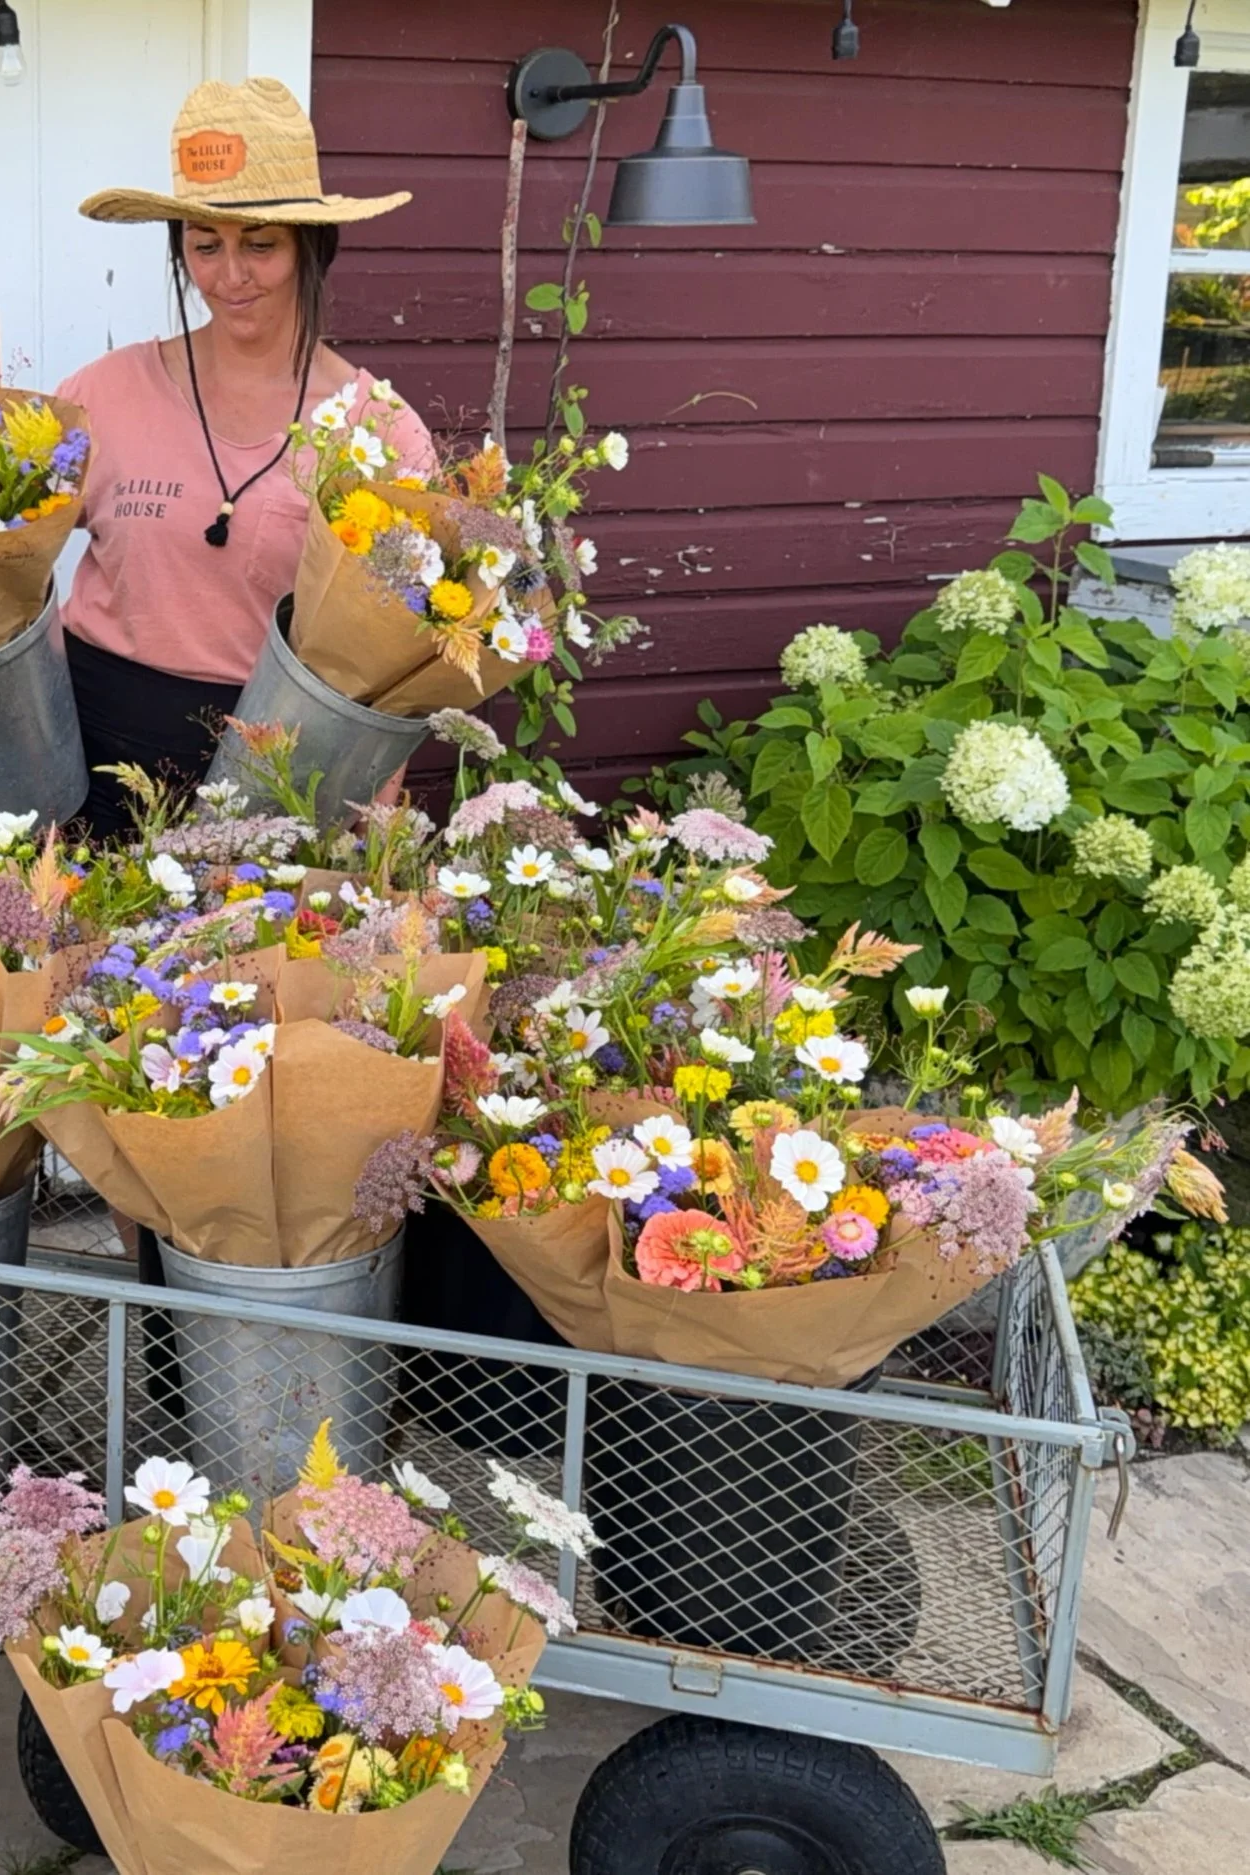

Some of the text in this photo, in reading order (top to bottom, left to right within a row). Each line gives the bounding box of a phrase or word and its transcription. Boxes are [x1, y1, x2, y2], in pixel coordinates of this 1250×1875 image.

[199, 143, 233, 157] LILLIE
[192, 159, 225, 172] HOUSE
[128, 479, 184, 499] LILLIE
[113, 501, 167, 519] HOUSE
